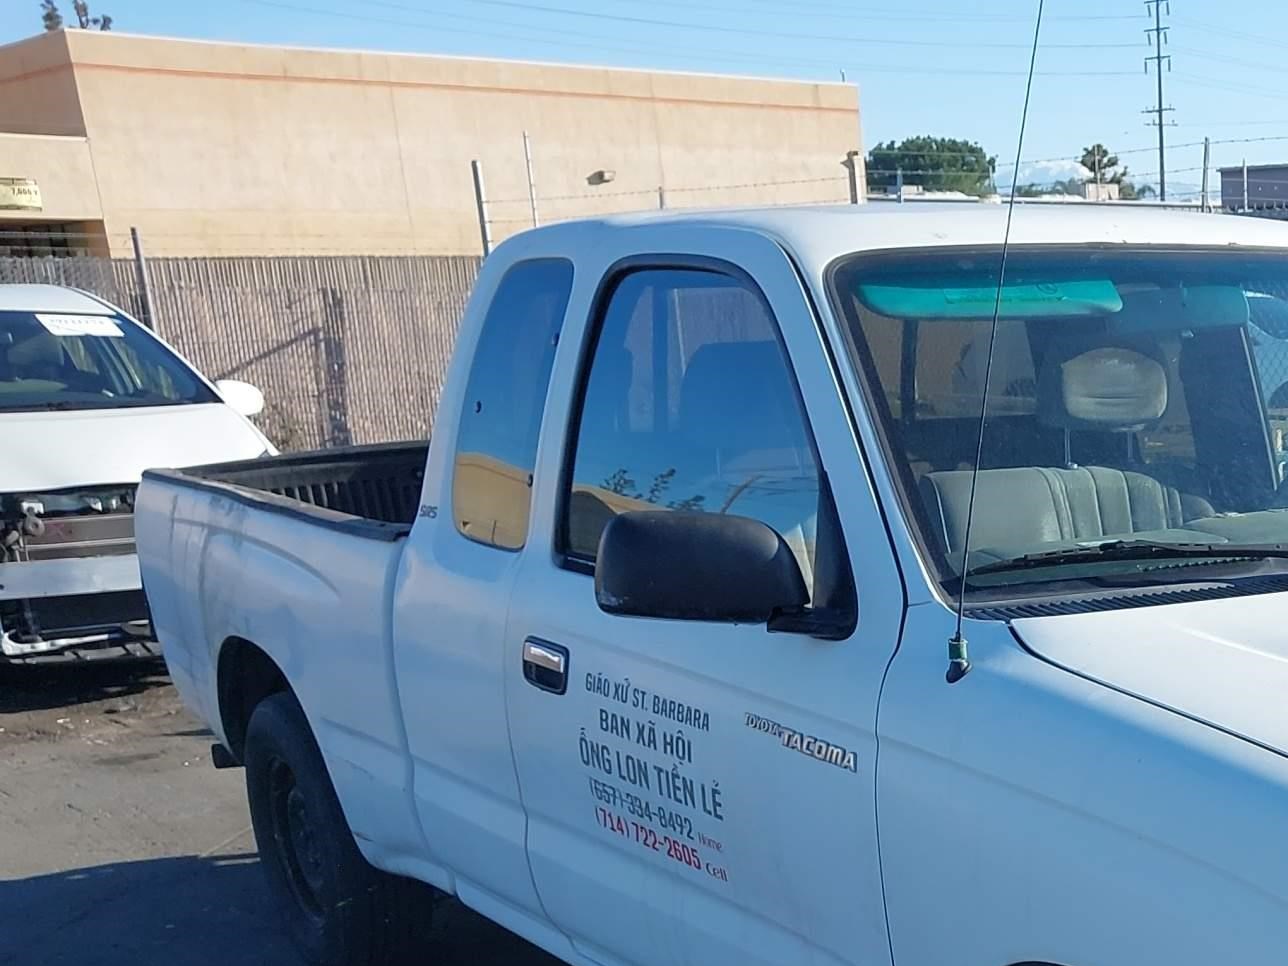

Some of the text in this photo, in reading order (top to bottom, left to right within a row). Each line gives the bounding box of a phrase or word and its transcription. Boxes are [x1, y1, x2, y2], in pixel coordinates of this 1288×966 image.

[585, 672, 610, 698] GIÁO
[632, 688, 648, 712] ST.
[652, 694, 710, 732] BARBARA
[599, 708, 692, 766] BAN XÃ HỘI
[745, 712, 858, 773] TOYOTA TACOMA
[616, 751, 651, 791] LON
[595, 806, 729, 882] (714) 722-2605 Cell
